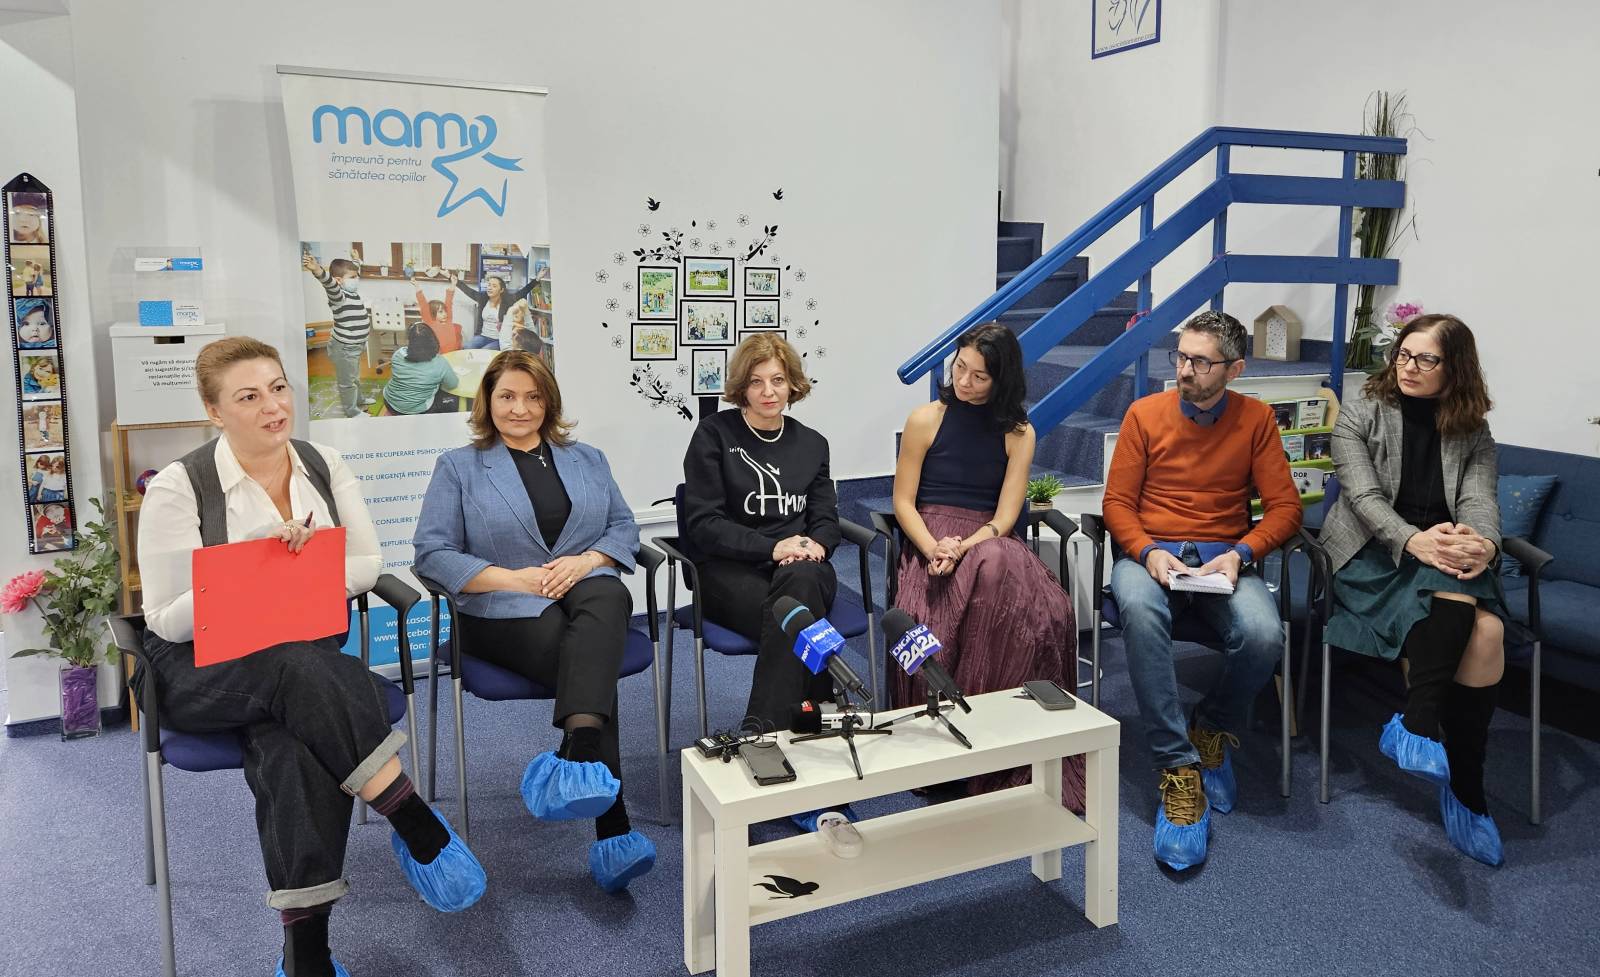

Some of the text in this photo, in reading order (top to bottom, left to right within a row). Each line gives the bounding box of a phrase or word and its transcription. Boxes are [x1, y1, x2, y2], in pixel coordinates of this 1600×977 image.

[331, 152, 422, 168] împreună pentru
[328, 169, 426, 184] sănătatea copiilor
[341, 453, 364, 461] ERVICII
[375, 449, 415, 459] RECUPERARE
[407, 470, 431, 478] PENTRU
[909, 625, 928, 638] DIGI
[892, 635, 912, 657] DIGI
[916, 632, 942, 652] 24
[898, 643, 925, 670] 24
